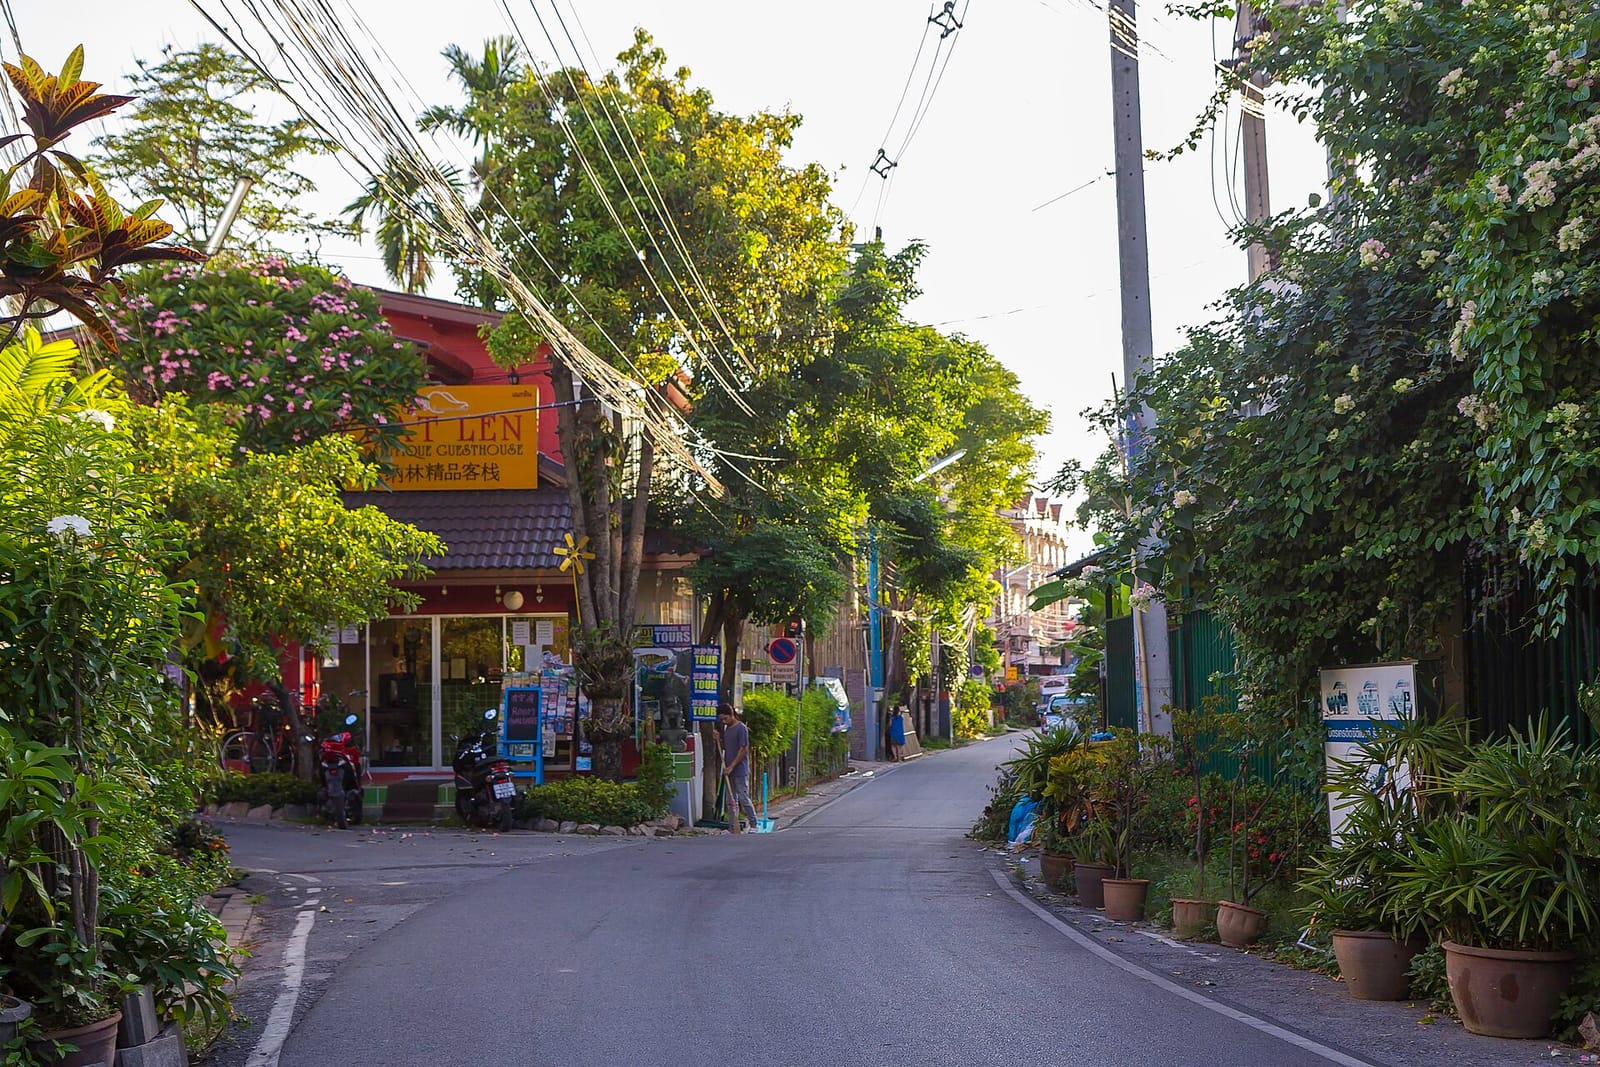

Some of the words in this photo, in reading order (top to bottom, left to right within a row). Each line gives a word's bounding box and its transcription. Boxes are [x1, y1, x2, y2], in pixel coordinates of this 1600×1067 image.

[458, 415, 523, 442] LEN
[436, 444, 523, 456] GUESTHOUSE
[654, 632, 690, 643] TOURS
[694, 655, 718, 665] TOUR
[693, 680, 717, 690] TOUR
[692, 706, 717, 716] TOUR
